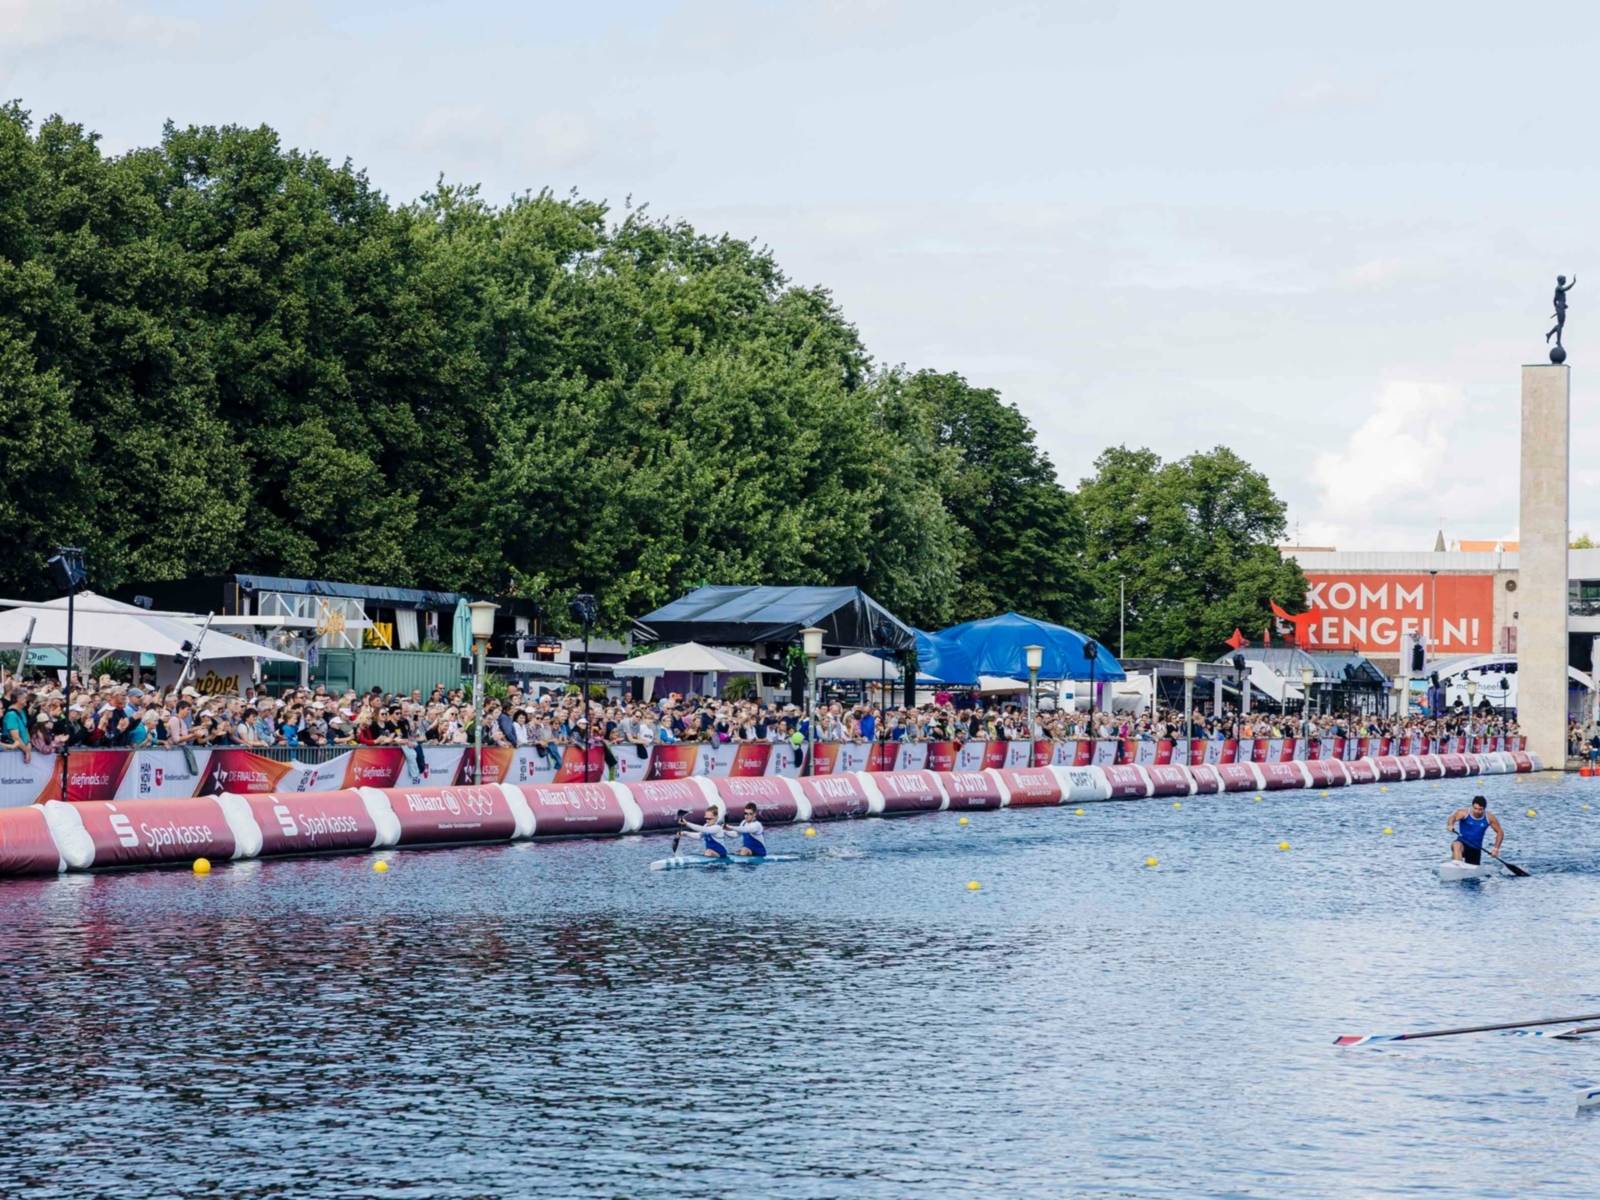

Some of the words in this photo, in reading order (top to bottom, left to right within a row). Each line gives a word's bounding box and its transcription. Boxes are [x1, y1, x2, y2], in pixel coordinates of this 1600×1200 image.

[1305, 582, 1424, 611] KOMM
[405, 793, 447, 812] Allianz
[536, 788, 569, 806] Allianz
[141, 822, 213, 850] Sparkasse
[299, 810, 358, 841] Sparkasse
